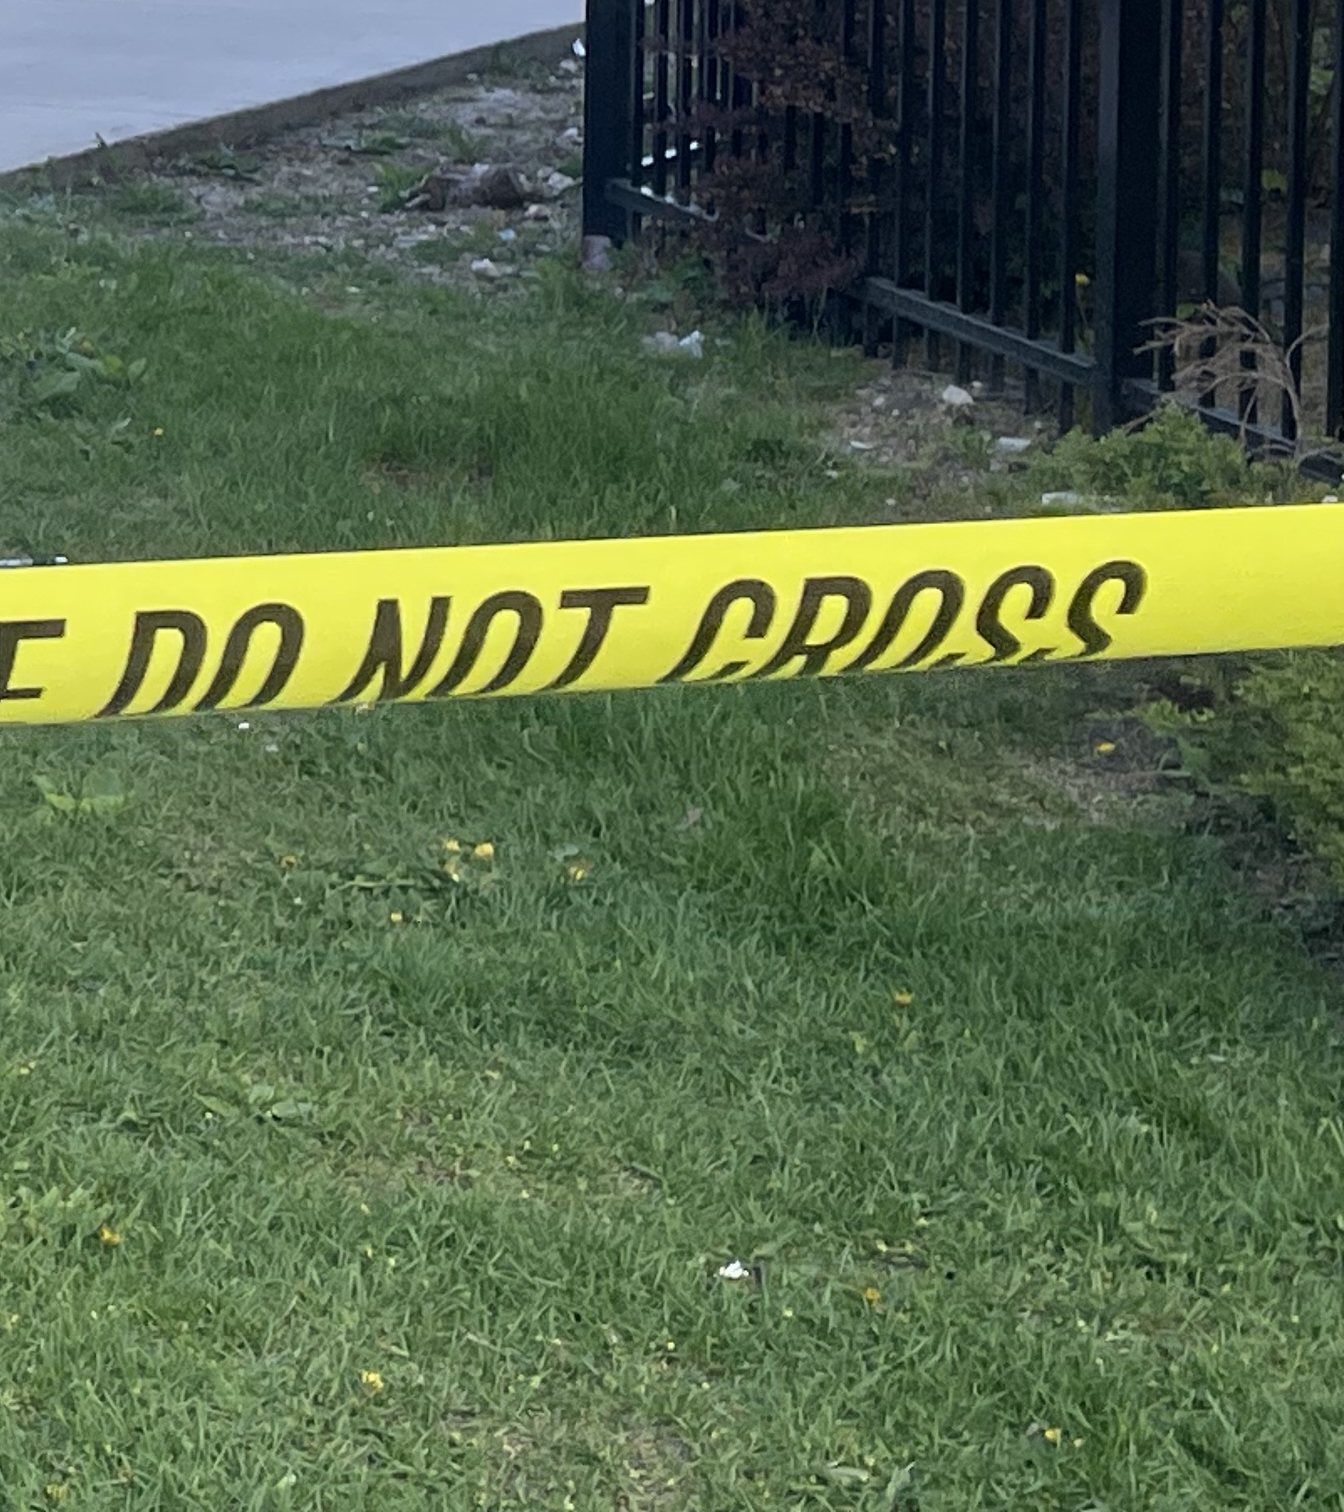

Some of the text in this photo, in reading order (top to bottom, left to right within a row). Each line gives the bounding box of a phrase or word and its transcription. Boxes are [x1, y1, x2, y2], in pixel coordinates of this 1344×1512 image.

[94, 602, 305, 719] DO
[326, 585, 651, 706] NOT
[658, 560, 1150, 685] CROSS
